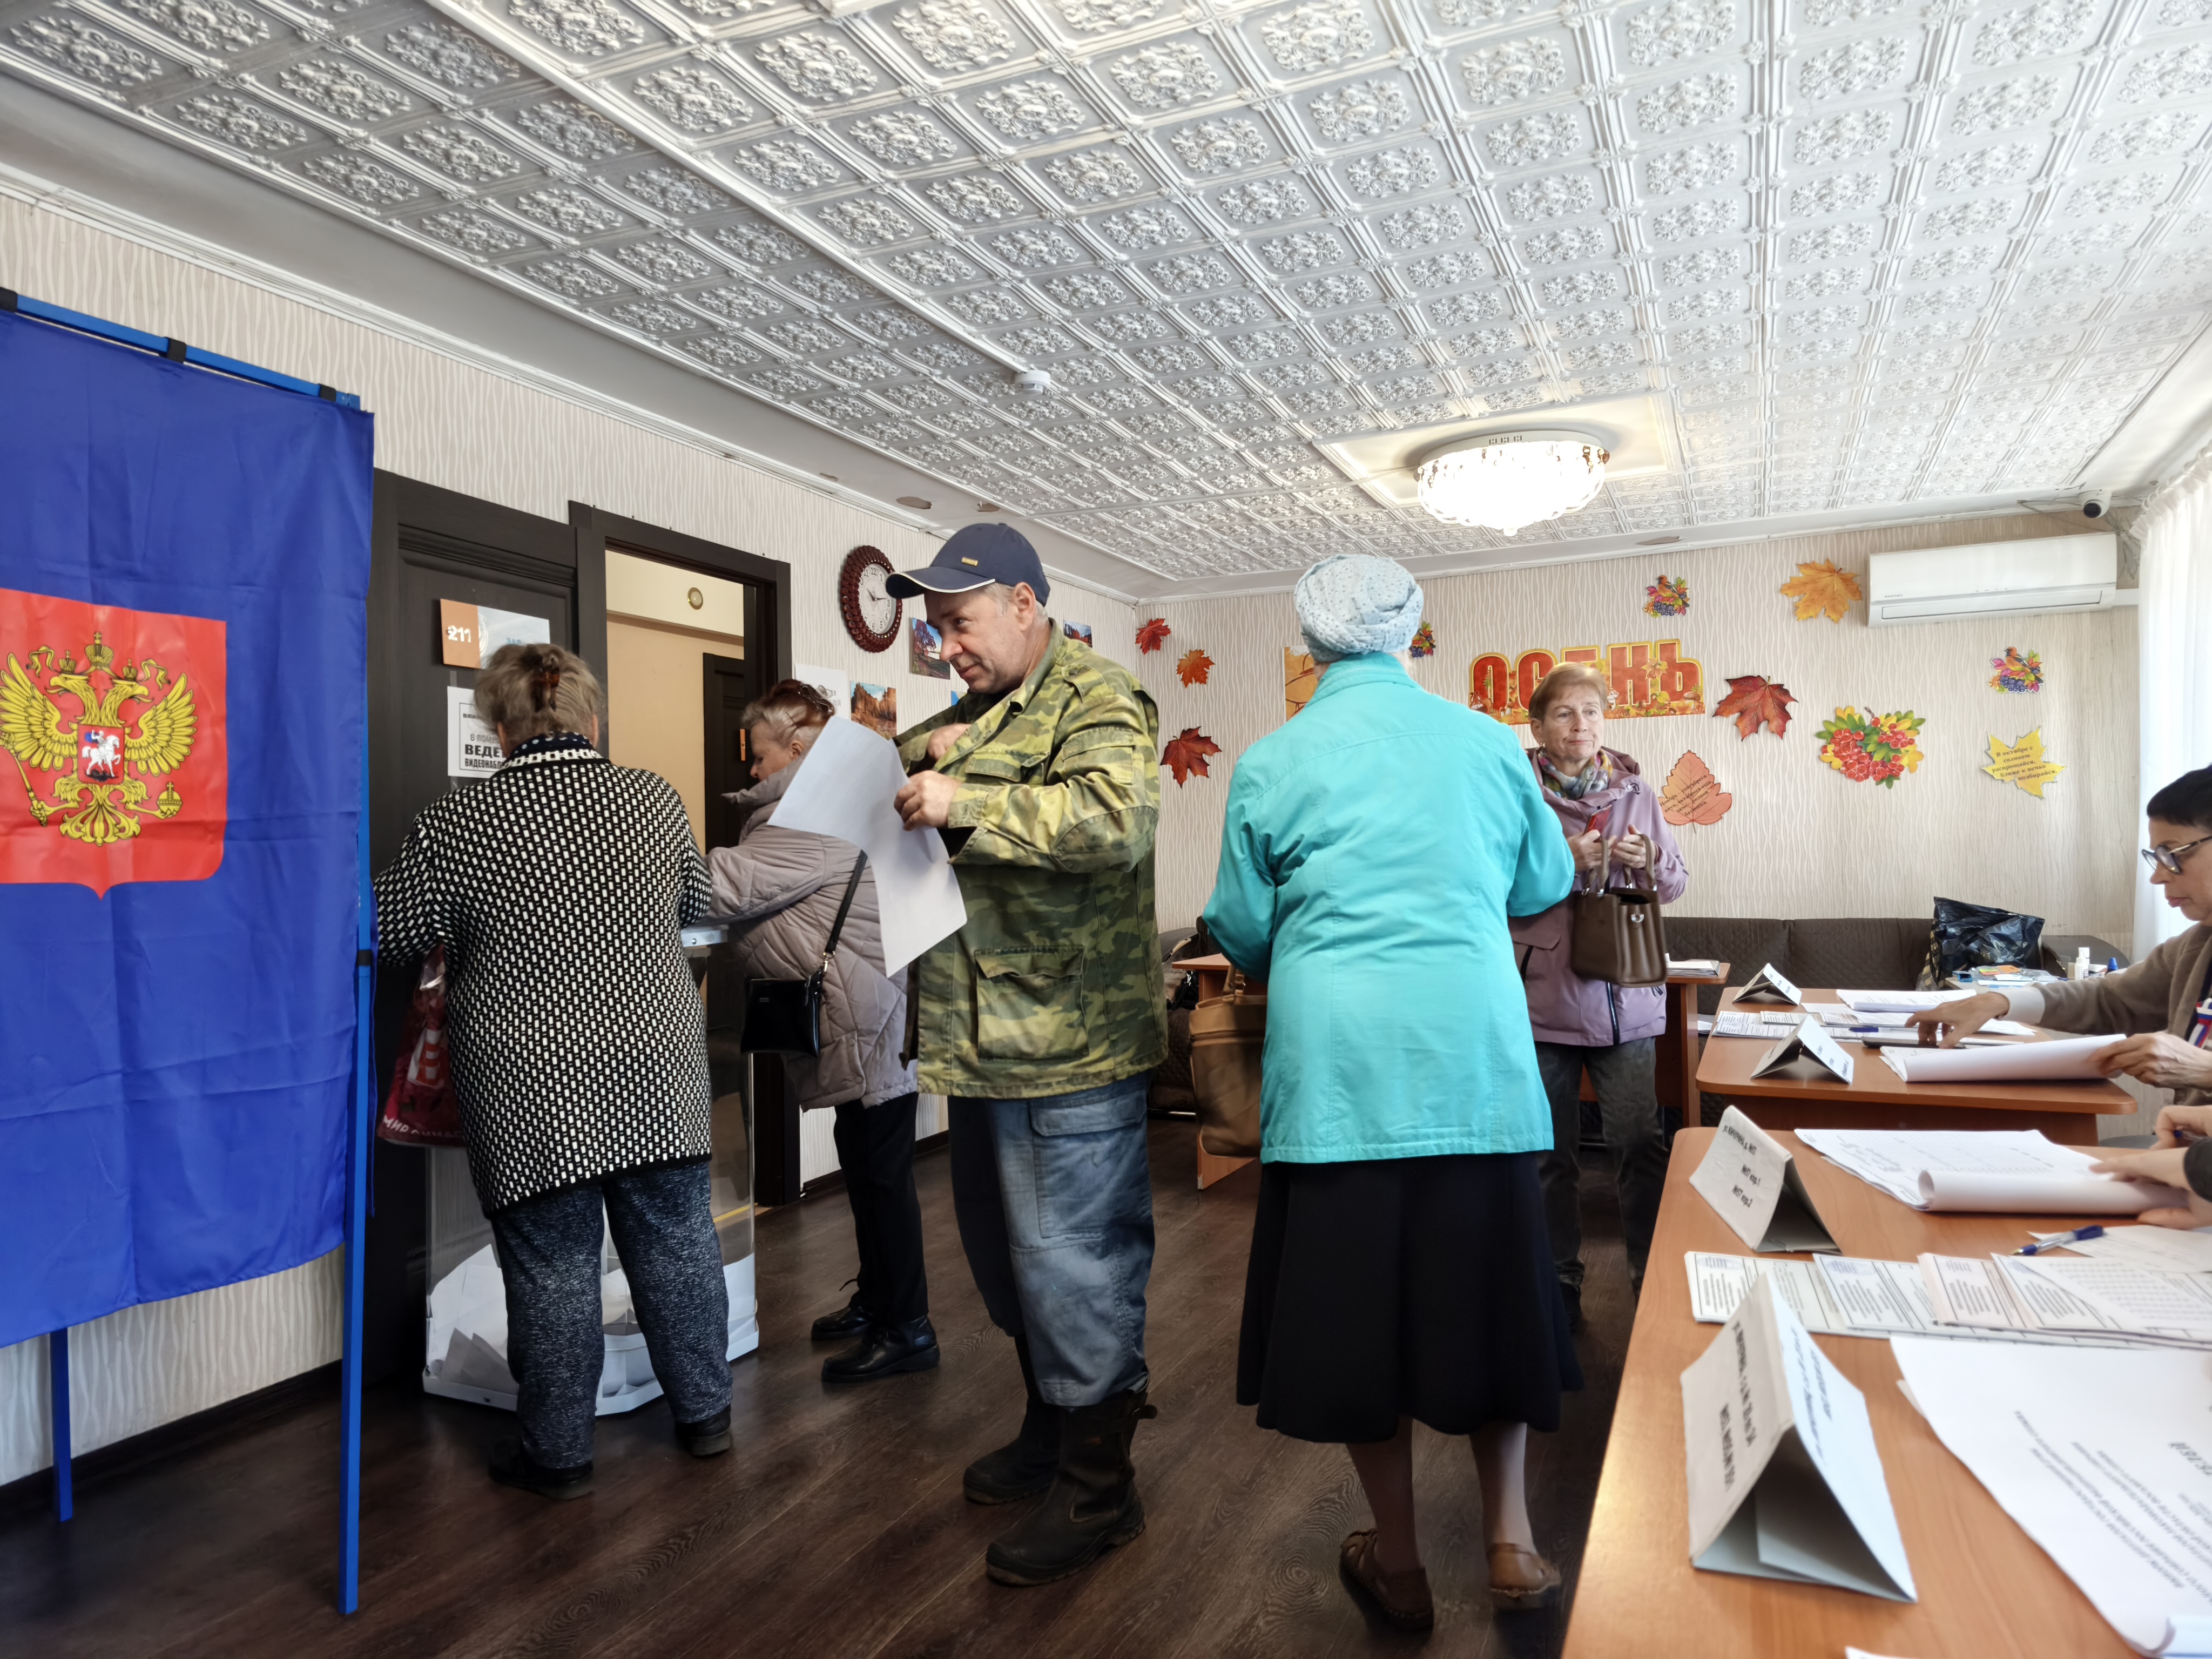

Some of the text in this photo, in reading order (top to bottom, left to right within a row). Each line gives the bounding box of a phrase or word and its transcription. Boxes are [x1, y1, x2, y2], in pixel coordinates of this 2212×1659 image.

[864, 569, 868, 577] 11
[871, 567, 876, 576] 12
[880, 574, 883, 582] 1
[887, 599, 891, 608] 3
[885, 612, 888, 621] 4
[872, 622, 875, 631] 6
[879, 621, 884, 629] 5
[448, 625, 471, 643] 211
[1471, 640, 1701, 713] ОСНЬ
[470, 733, 500, 744] В ПОМЕ
[465, 744, 503, 758] ВЕДЕ
[2002, 747, 2028, 756] октябре
[2003, 754, 2031, 763] солнцем
[465, 758, 502, 770] ВИДЕОНАБЛ
[2027, 764, 2046, 772] печке
[1691, 791, 1709, 804] родной
